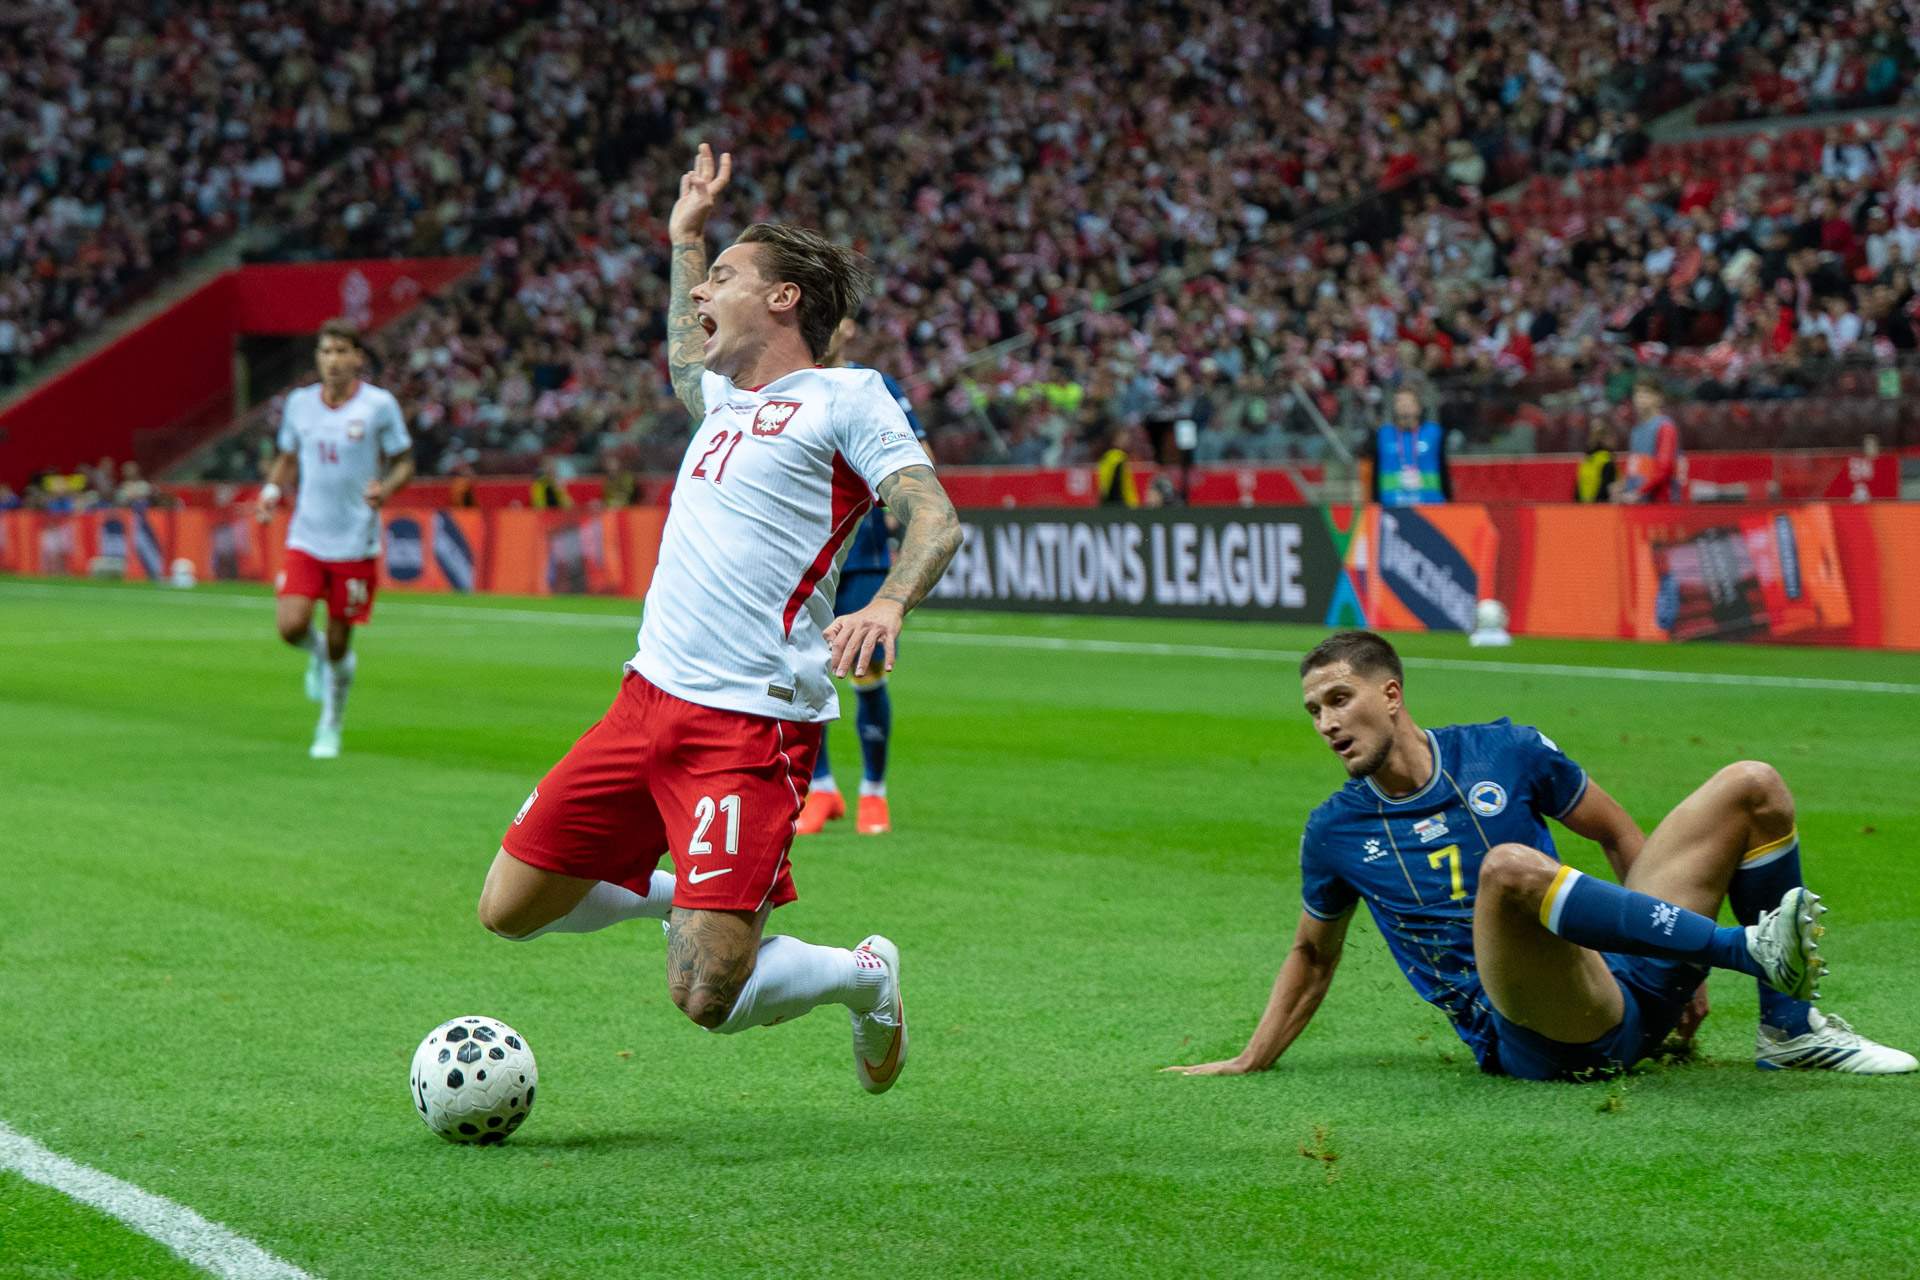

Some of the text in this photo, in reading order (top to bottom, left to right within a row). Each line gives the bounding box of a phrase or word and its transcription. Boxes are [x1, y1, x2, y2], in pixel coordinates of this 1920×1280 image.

[318, 440, 340, 464] 14
[691, 430, 743, 485] 21
[928, 522, 993, 600] EFA
[993, 522, 1147, 605] NATIONS
[1150, 522, 1307, 608] LEAGUE
[688, 795, 741, 856] 21
[1427, 844, 1468, 900] 7
